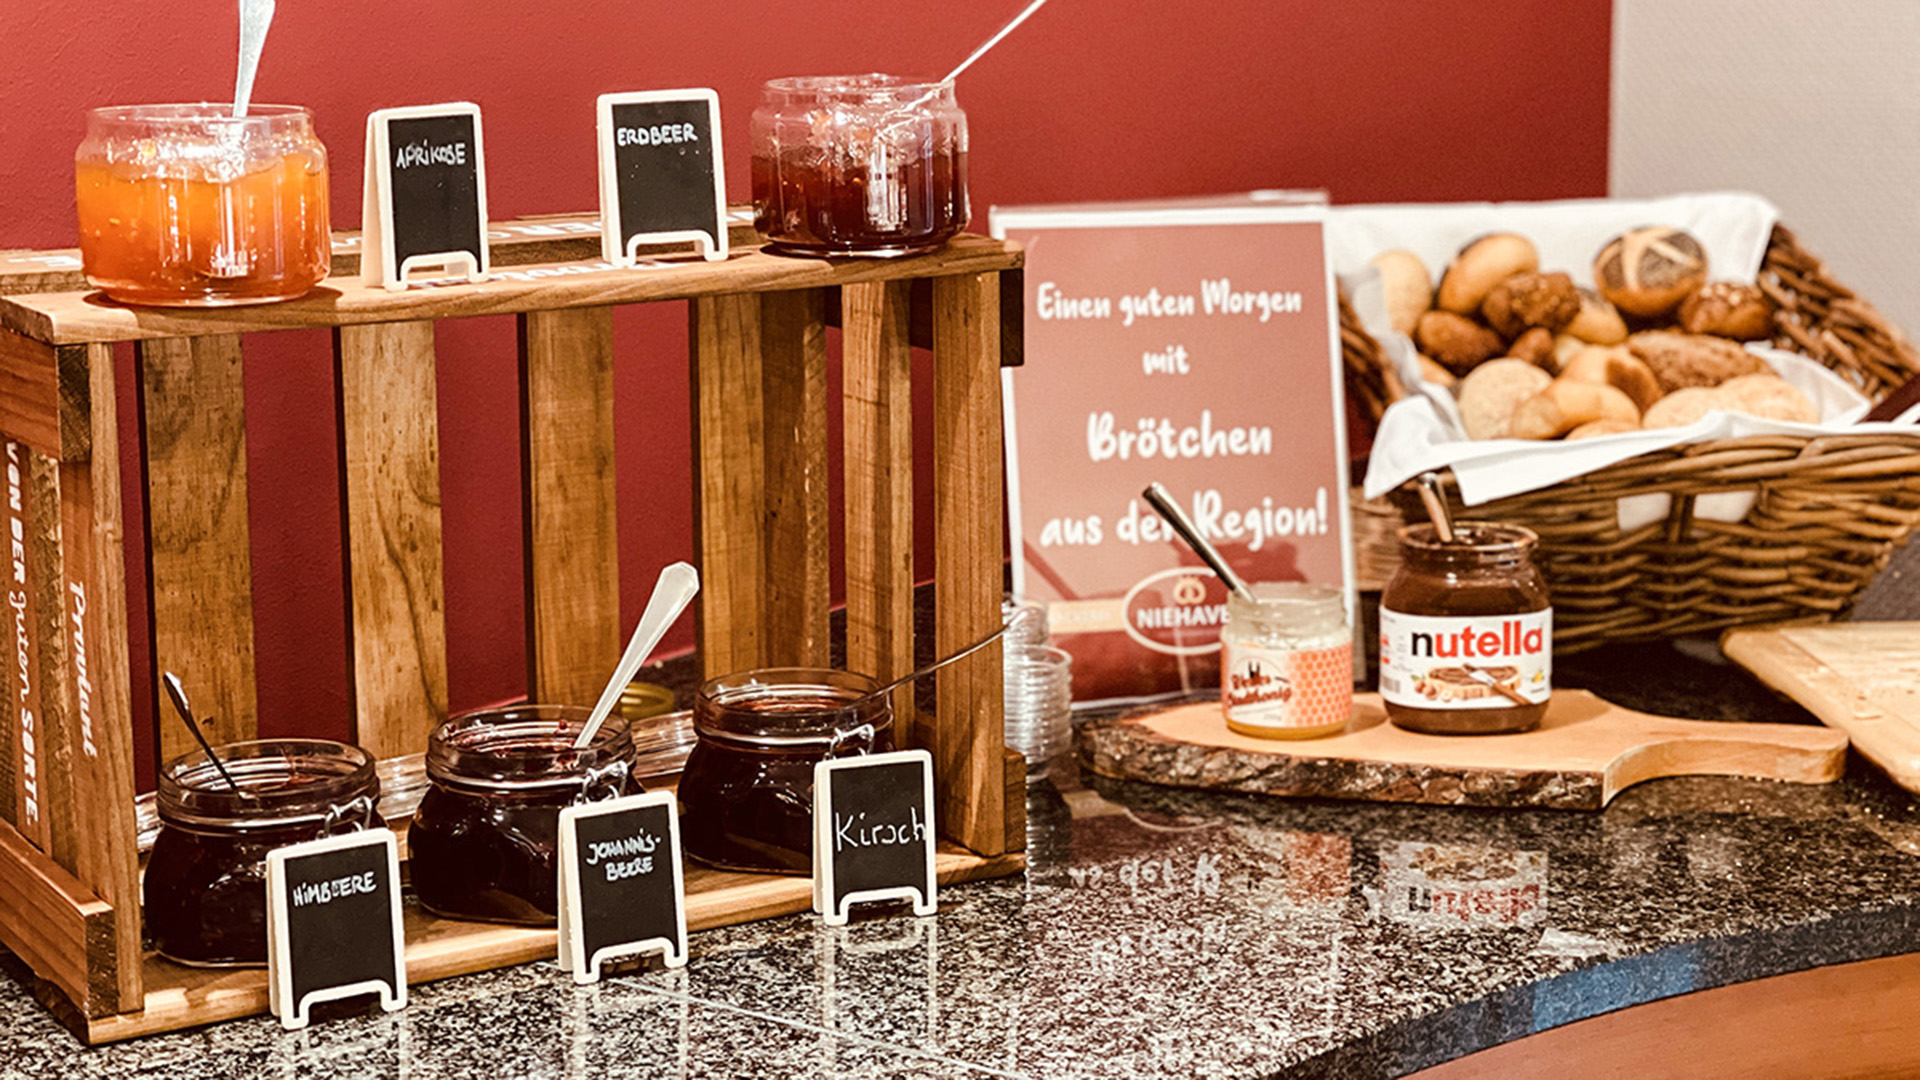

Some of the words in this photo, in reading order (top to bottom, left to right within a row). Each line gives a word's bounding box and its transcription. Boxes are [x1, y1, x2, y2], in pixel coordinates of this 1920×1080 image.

[617, 123, 698, 147] ERDBEER
[1037, 281, 1111, 320] Einen
[1119, 287, 1195, 327] guten
[1200, 277, 1302, 323] Morgen
[1142, 344, 1190, 375] mit
[1086, 409, 1272, 462] Brötchen
[6, 442, 22, 512] VON
[1040, 515, 1103, 547] aus
[1193, 487, 1328, 551] Region!
[10, 516, 26, 584] DER
[1137, 605, 1230, 630] NIEHAVE
[1411, 620, 1544, 658] nutella
[9, 590, 31, 703] guten
[69, 580, 98, 758] Proviant
[21, 707, 39, 826] SORTE.
[835, 806, 928, 852] Kirsch
[605, 856, 655, 882] BEERE
